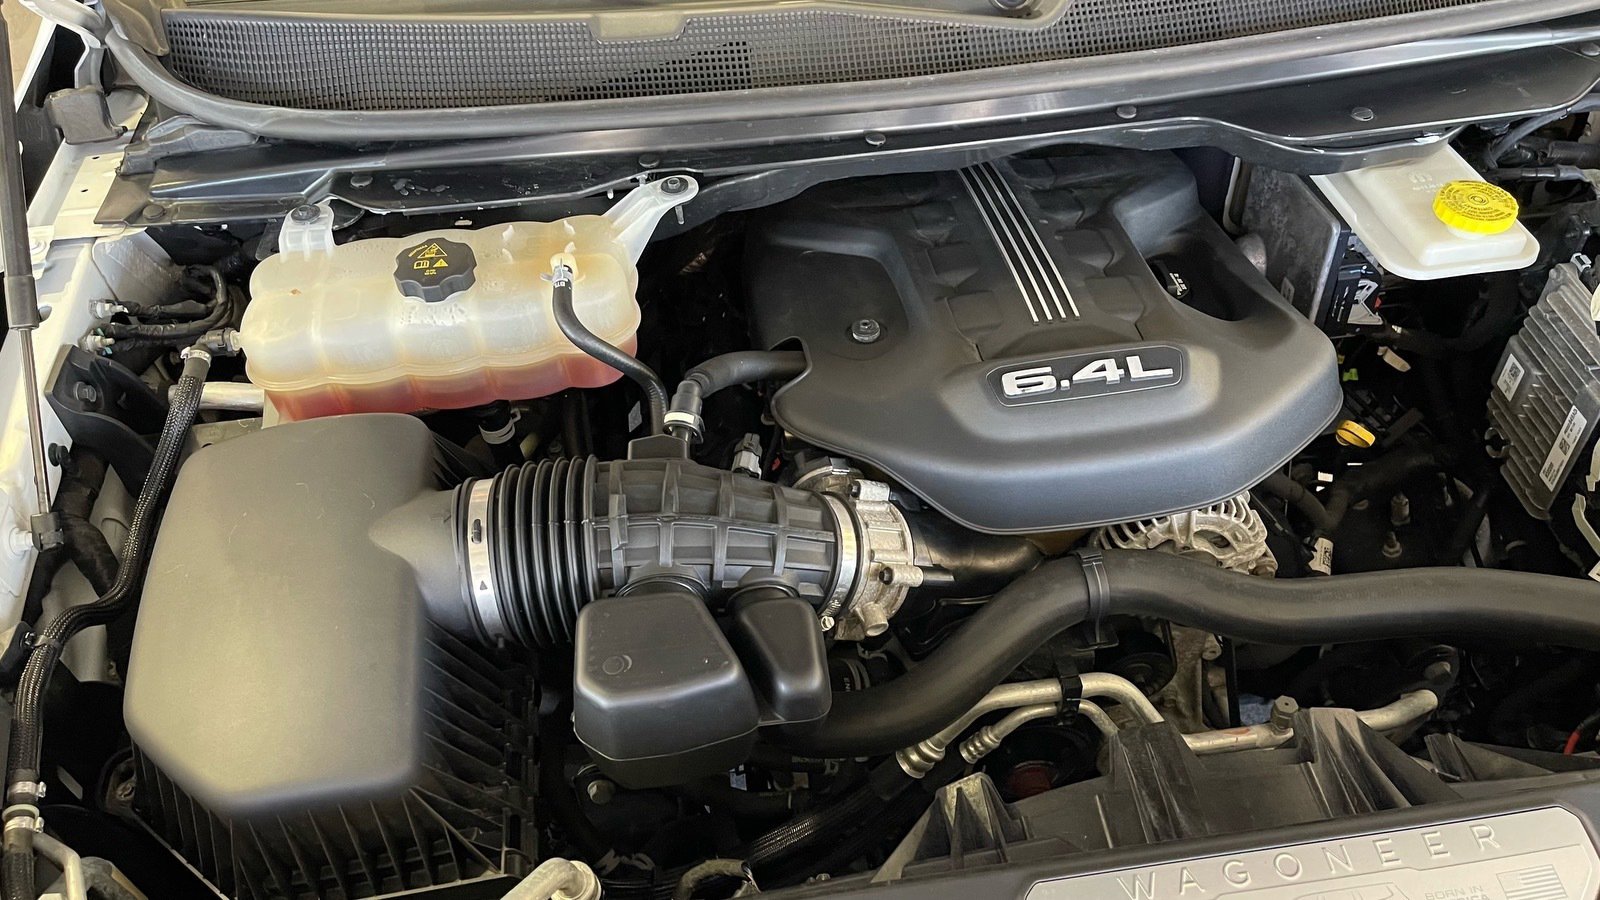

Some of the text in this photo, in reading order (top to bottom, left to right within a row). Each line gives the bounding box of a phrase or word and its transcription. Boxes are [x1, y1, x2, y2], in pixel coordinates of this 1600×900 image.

[1002, 356, 1173, 398] 6.4L
[1116, 823, 1502, 900] WAGONEER
[1425, 888, 1466, 900] BORN
[1470, 885, 1483, 894] IN
